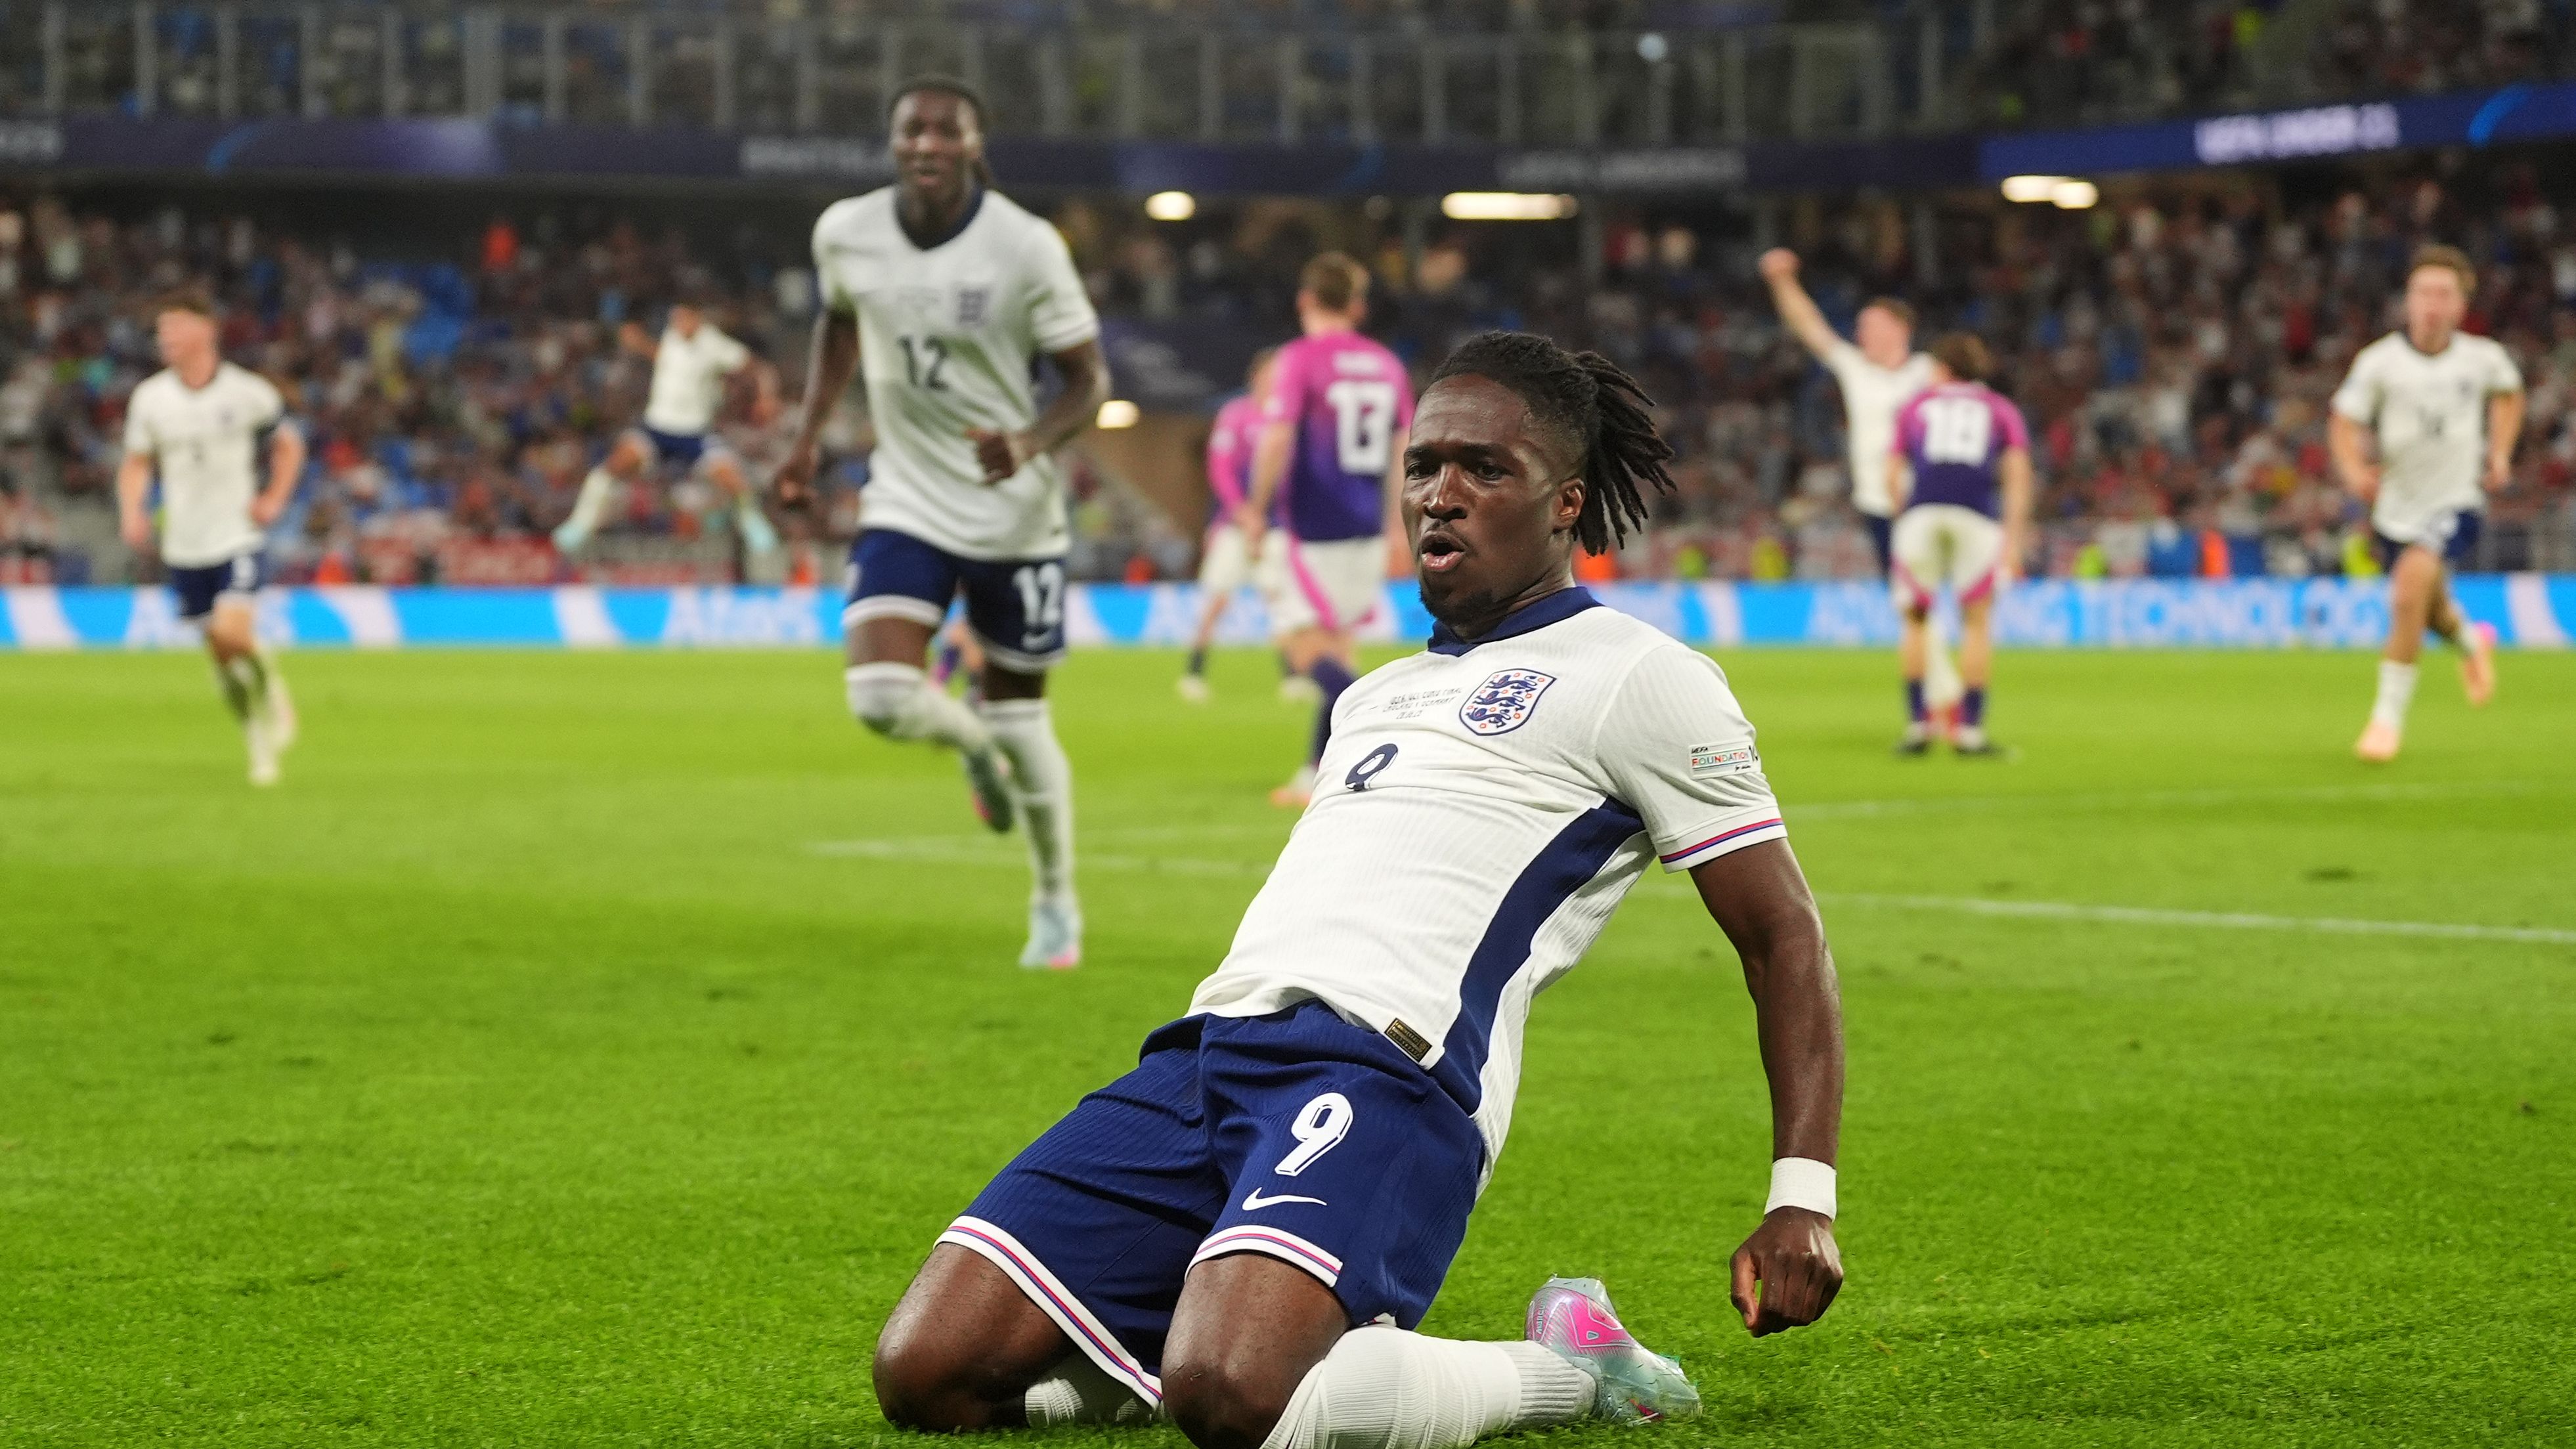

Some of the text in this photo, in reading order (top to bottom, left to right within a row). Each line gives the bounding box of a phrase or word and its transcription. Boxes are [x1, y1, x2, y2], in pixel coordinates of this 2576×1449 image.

[898, 335, 949, 391] 12
[1327, 379, 1398, 474] 13
[1013, 563, 1063, 624] 12
[1275, 1092, 1354, 1177] 9
